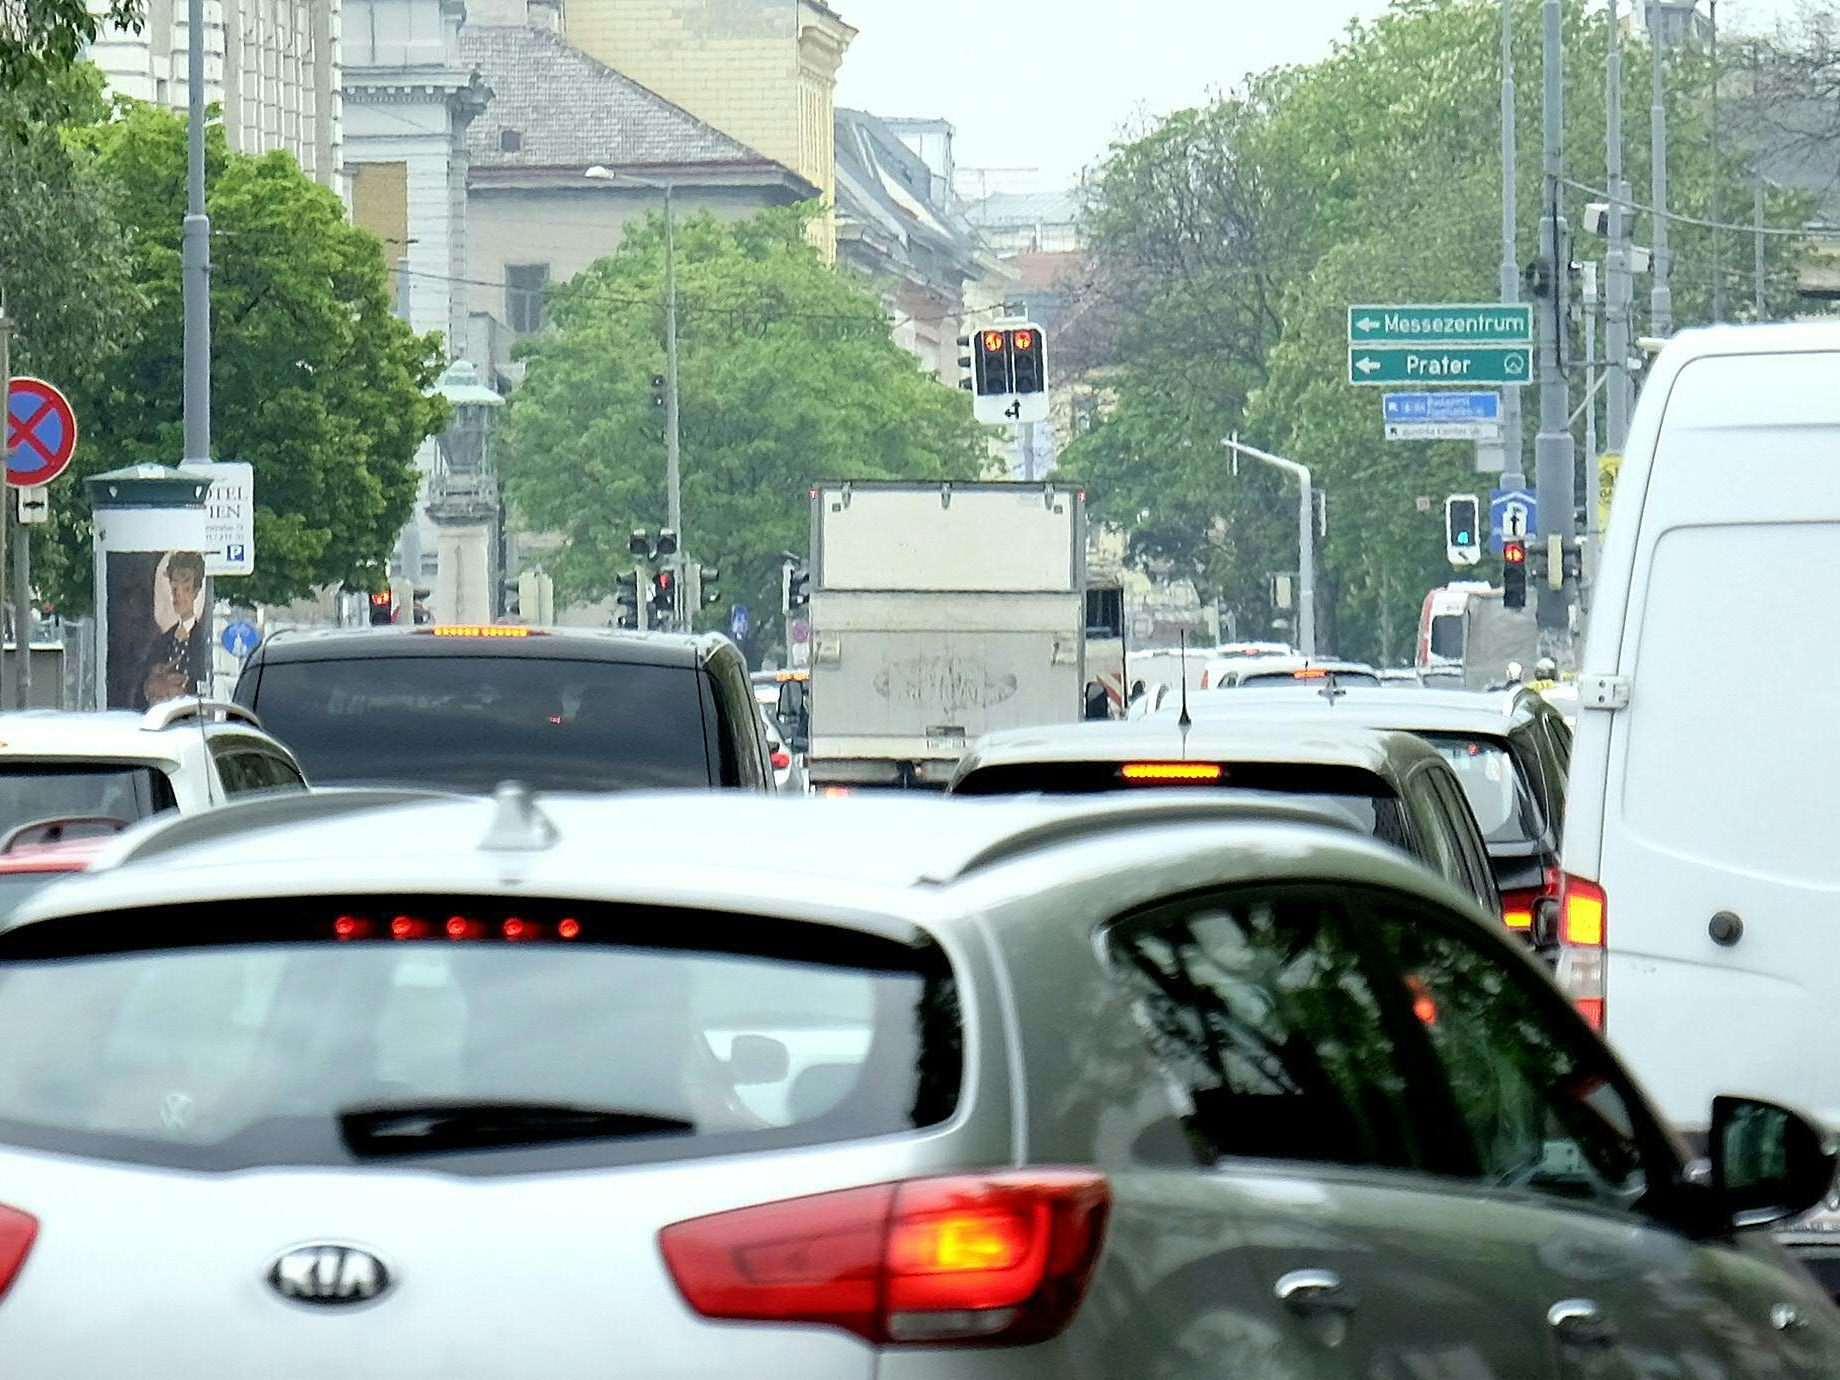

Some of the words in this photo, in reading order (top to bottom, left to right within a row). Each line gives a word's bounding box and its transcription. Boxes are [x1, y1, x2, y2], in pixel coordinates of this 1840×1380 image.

[1384, 313, 1524, 333] Messezentrum
[1406, 354, 1471, 375] Prater
[274, 1247, 384, 1301] KIA
